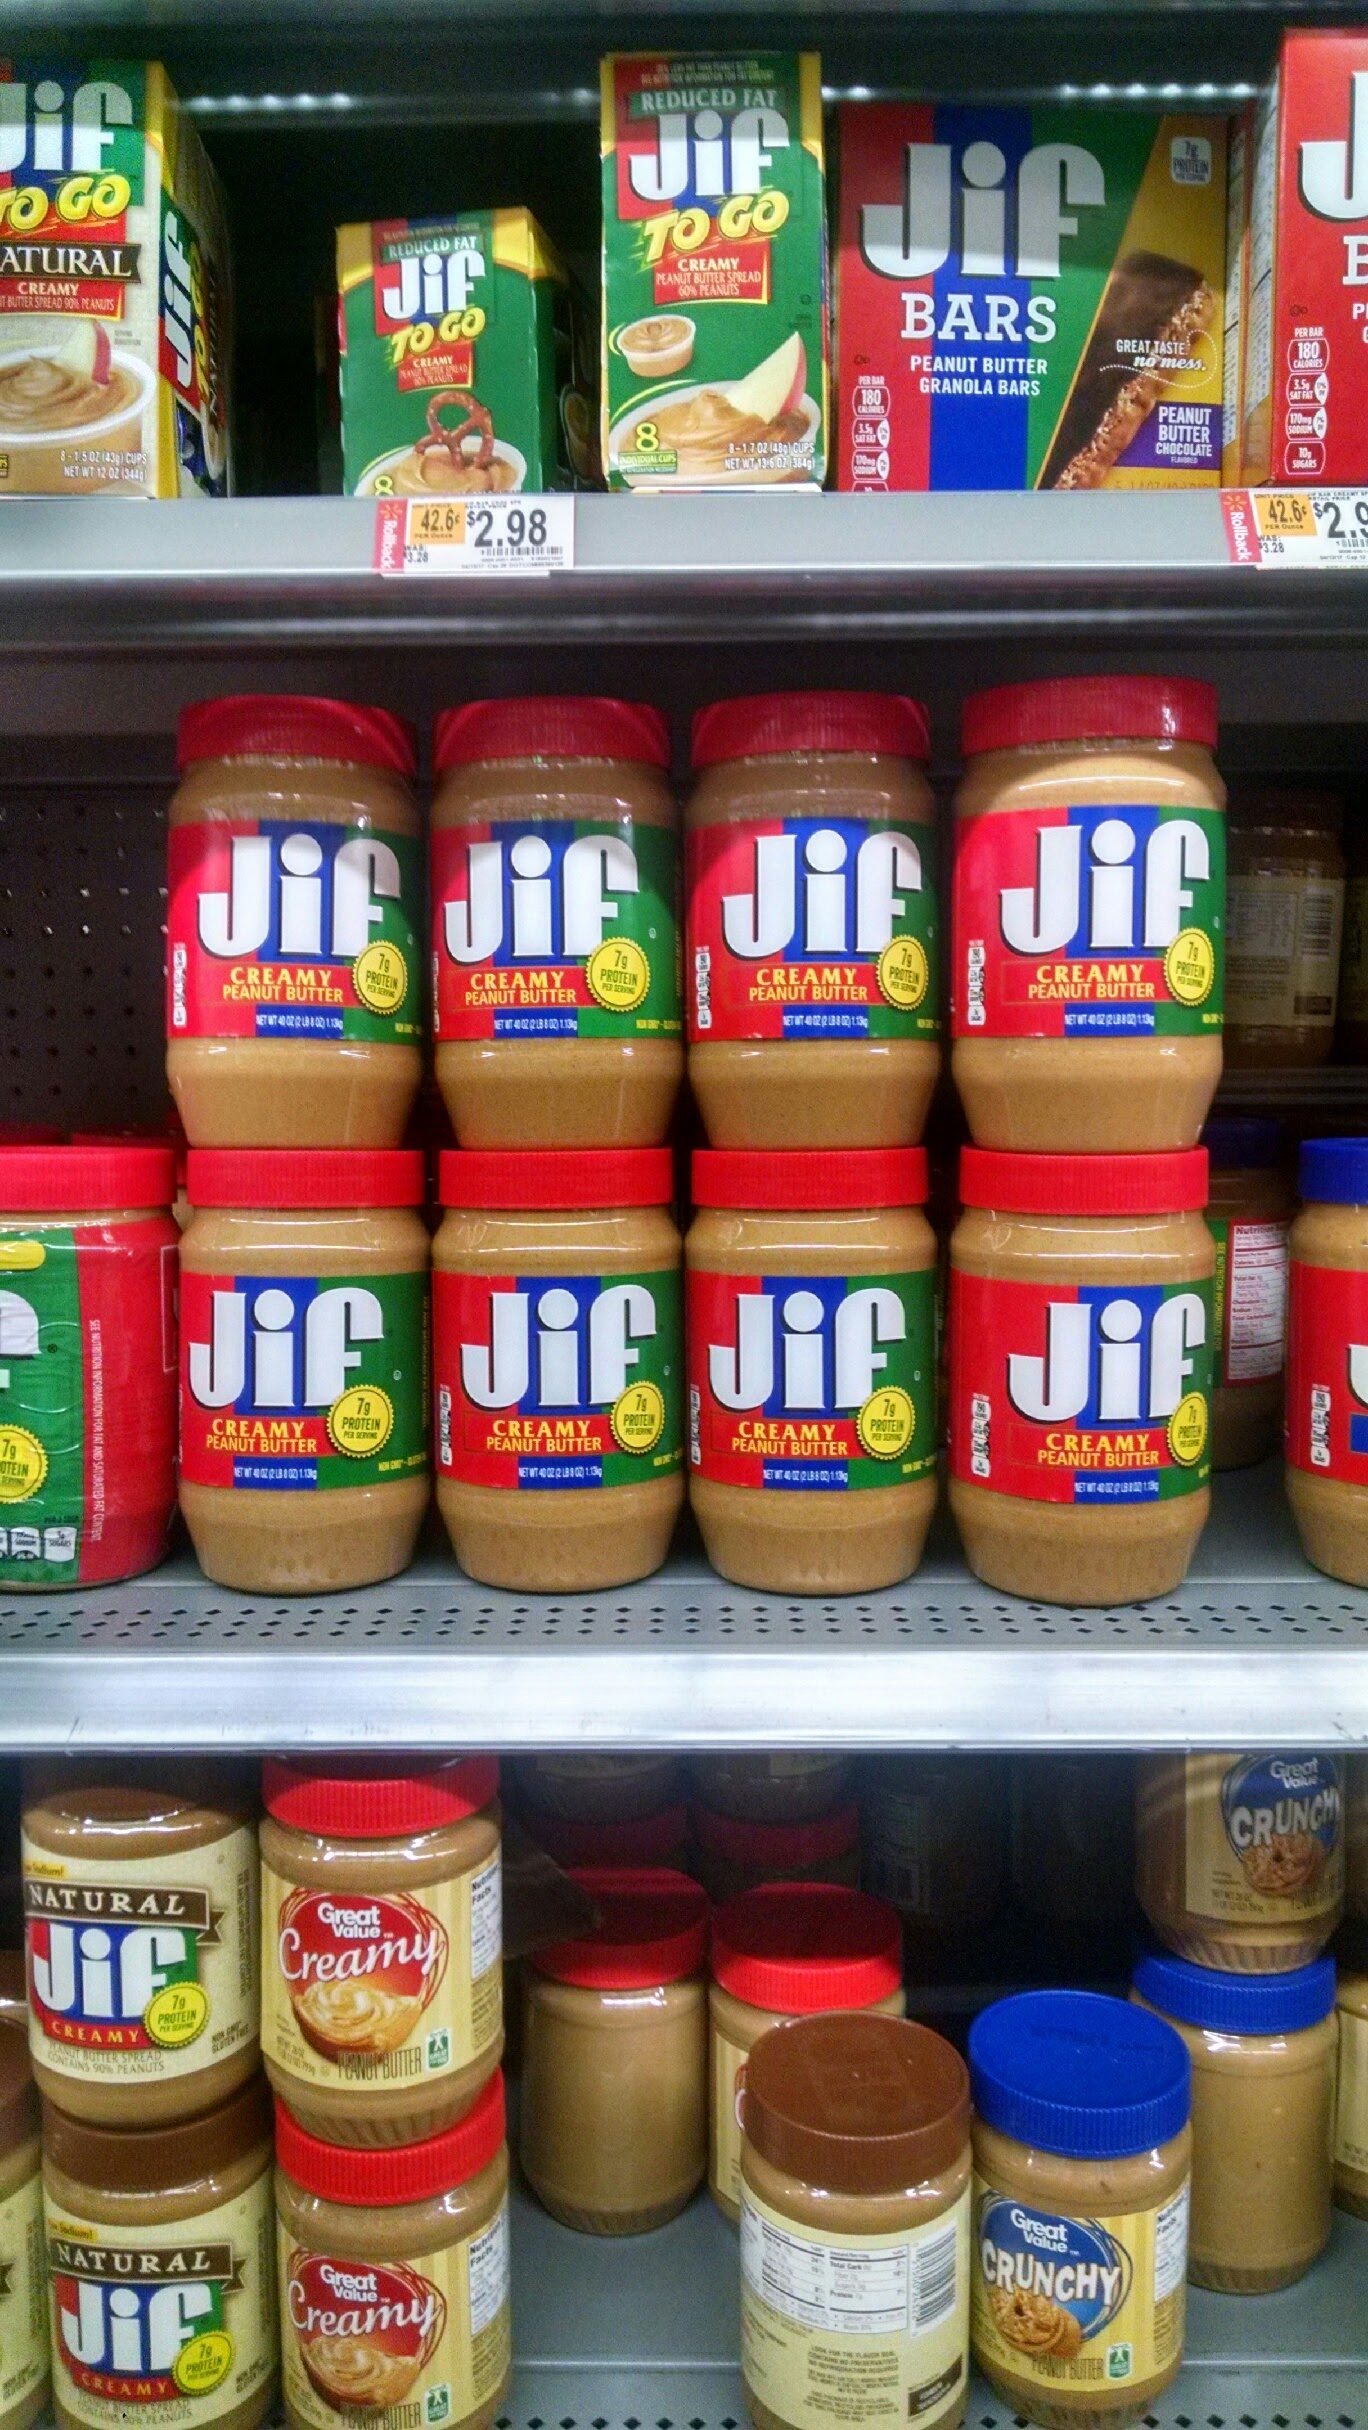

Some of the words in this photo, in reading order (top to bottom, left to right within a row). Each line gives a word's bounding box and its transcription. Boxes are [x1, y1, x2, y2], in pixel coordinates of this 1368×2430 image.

[641, 89, 736, 110] REDUCED
[743, 87, 779, 107] FAT
[629, 109, 790, 200] Jif
[56, 174, 132, 221] GO
[861, 142, 1106, 279] Jif
[643, 207, 711, 263] TO
[718, 190, 790, 240] GO
[388, 239, 451, 259] REDUCED
[454, 235, 478, 252] FAT
[0, 245, 132, 277] ATURAL
[677, 258, 740, 272] CREAMY
[17, 281, 80, 296] CREAMY
[382, 249, 486, 319] Jif
[656, 273, 691, 286] PEANUT
[693, 272, 726, 285] BUTTER
[727, 271, 762, 283] SPREAD
[700, 284, 740, 296] PEANUTS
[82, 298, 116, 311] PEANUTS
[901, 291, 1057, 344] BARS
[390, 321, 436, 364] TO
[439, 307, 487, 342] GO
[1294, 327, 1308, 337] PER
[1309, 327, 1323, 336] BAR
[1116, 339, 1151, 355] GREAT
[1297, 342, 1320, 359] 180
[413, 356, 455, 369] CREAMY
[910, 355, 978, 374] PEANUT
[982, 357, 1048, 375] BUTTER
[1160, 356, 1207, 372] mess.
[1293, 359, 1323, 369] CALORIES
[919, 376, 993, 396] GRANOLA
[997, 378, 1041, 396] BARS
[1289, 391, 1302, 400] SAT
[1302, 390, 1313, 399] FAT
[1294, 379, 1310, 392] 3.5g
[861, 389, 881, 405] 180
[1158, 406, 1211, 425] PEANUT
[636, 421, 660, 452] 8
[1158, 425, 1210, 444] BUTTER
[1156, 442, 1213, 458] CHOCOLATE
[1298, 447, 1312, 460] 10g
[1292, 459, 1317, 468] SUGARS
[466, 508, 548, 548] $2.98
[1313, 501, 1368, 539] $2.9
[1229, 511, 1253, 562] Rollback
[198, 834, 400, 957] Jif
[722, 830, 922, 957] Jif
[1000, 820, 1210, 954] Jif
[445, 835, 640, 964] Jif
[614, 949, 628, 970] 7g
[230, 967, 332, 985] CREAMY
[470, 971, 565, 991] CREAMY
[599, 968, 638, 986] PROTEIN
[756, 968, 858, 987] CREAMY
[1036, 964, 1145, 984] CREAMY
[222, 984, 281, 1001] PEANUT
[285, 985, 345, 1003] BUTTER
[465, 989, 516, 1007] PEANUT
[520, 988, 577, 1005] BUTTER
[748, 985, 807, 1002] PEANUT
[811, 985, 869, 1002] BUTTER
[1028, 983, 1091, 1000] PEANUT
[1096, 983, 1156, 999] BUTTER
[89, 1319, 101, 1330] SEE
[91, 1332, 102, 1369] NUTRITION
[189, 1287, 385, 1408] Jif
[461, 1284, 657, 1408] Jif
[708, 1288, 907, 1410] Jif
[1008, 1294, 1206, 1422] Jif
[92, 1370, 103, 1417] INFORMATION
[636, 1393, 648, 1412] 7g
[357, 1396, 372, 1418] 7g
[883, 1398, 896, 1419] 7g
[92, 1419, 104, 1432] FOR
[212, 1418, 307, 1440] CREAMY
[340, 1416, 381, 1431] PROTEIN
[493, 1419, 592, 1439] CREAMY
[622, 1413, 656, 1428] PROTEIN
[869, 1418, 904, 1434] PROTEIN
[738, 1421, 836, 1442] CREAMY
[3, 1439, 17, 1459] 7g
[93, 1445, 104, 1460] AND
[206, 1435, 258, 1453] PEANUT
[261, 1437, 318, 1454] BUTTER
[486, 1436, 543, 1453] PEANUT
[546, 1436, 603, 1453] BUTTER
[732, 1437, 788, 1456] PEANUT
[790, 1440, 849, 1457] BUTTER
[1046, 1433, 1151, 1453] CREAMY
[1037, 1450, 1101, 1468] PEANUT
[1105, 1451, 1161, 1467] BUTTER
[92, 1461, 104, 1499] SATURATED
[1270, 1757, 1319, 1780] Great
[28, 1883, 186, 1916] NATURAL
[317, 1901, 381, 1927] Great
[332, 1925, 381, 1939] Value
[280, 1927, 443, 1982] Creamy
[33, 1923, 187, 2018] Jif
[171, 1994, 186, 2011] 7g
[157, 2008, 197, 2025] PROTEIN
[51, 2020, 140, 2044] CREAMY
[117, 2062, 164, 2075] PEANUTS
[383, 2046, 422, 2080] BUTTER
[1010, 2208, 1068, 2242] Great
[1023, 2229, 1068, 2254] Value
[58, 2243, 211, 2275] NATURAL
[319, 2264, 378, 2291] Great
[982, 2238, 1121, 2306] CRUNCHY
[333, 2285, 379, 2303] Value
[289, 2279, 443, 2337] Creamy
[61, 2281, 213, 2371] Jif
[80, 2373, 168, 2397] CREAMY
